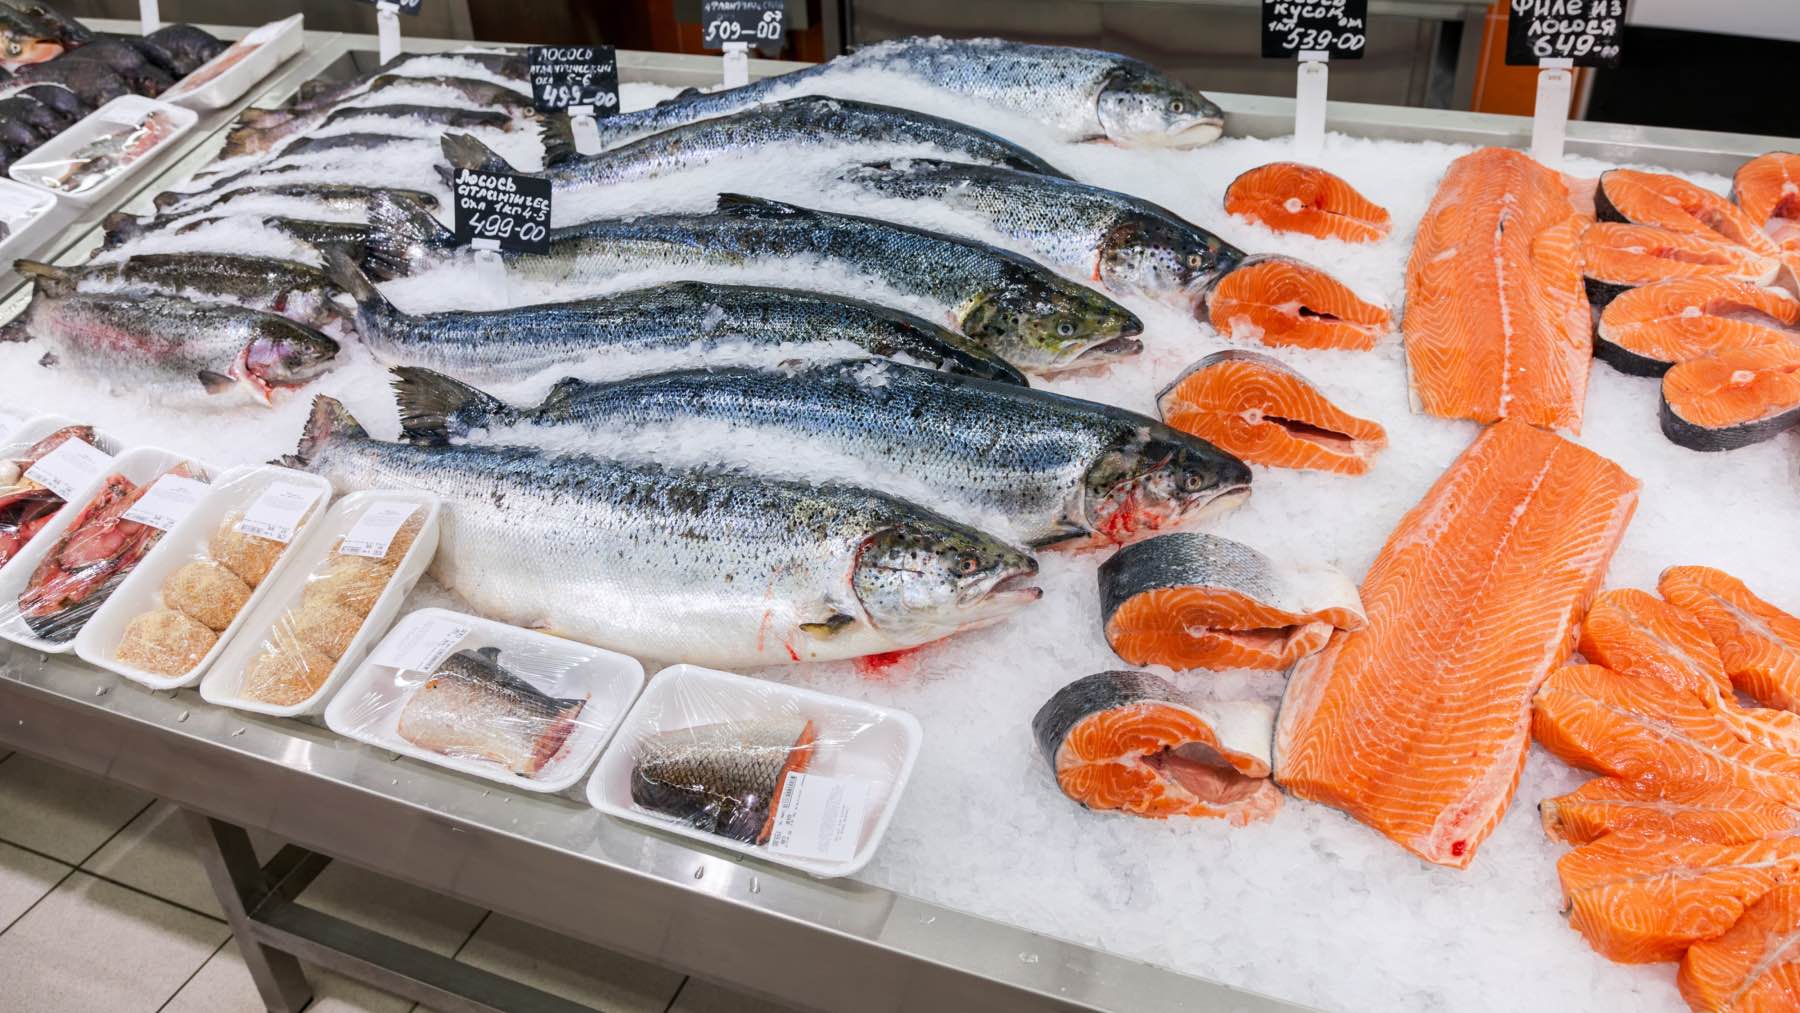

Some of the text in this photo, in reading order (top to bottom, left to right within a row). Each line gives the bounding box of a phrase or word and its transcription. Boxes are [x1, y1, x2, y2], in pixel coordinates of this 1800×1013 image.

[705, 20, 781, 41] 509-00
[1282, 27, 1365, 51] 539-00
[1533, 34, 1619, 58] 649-00
[543, 84, 617, 107] 499-00
[522, 207, 548, 221] 4-5
[469, 212, 546, 241] 499-00
